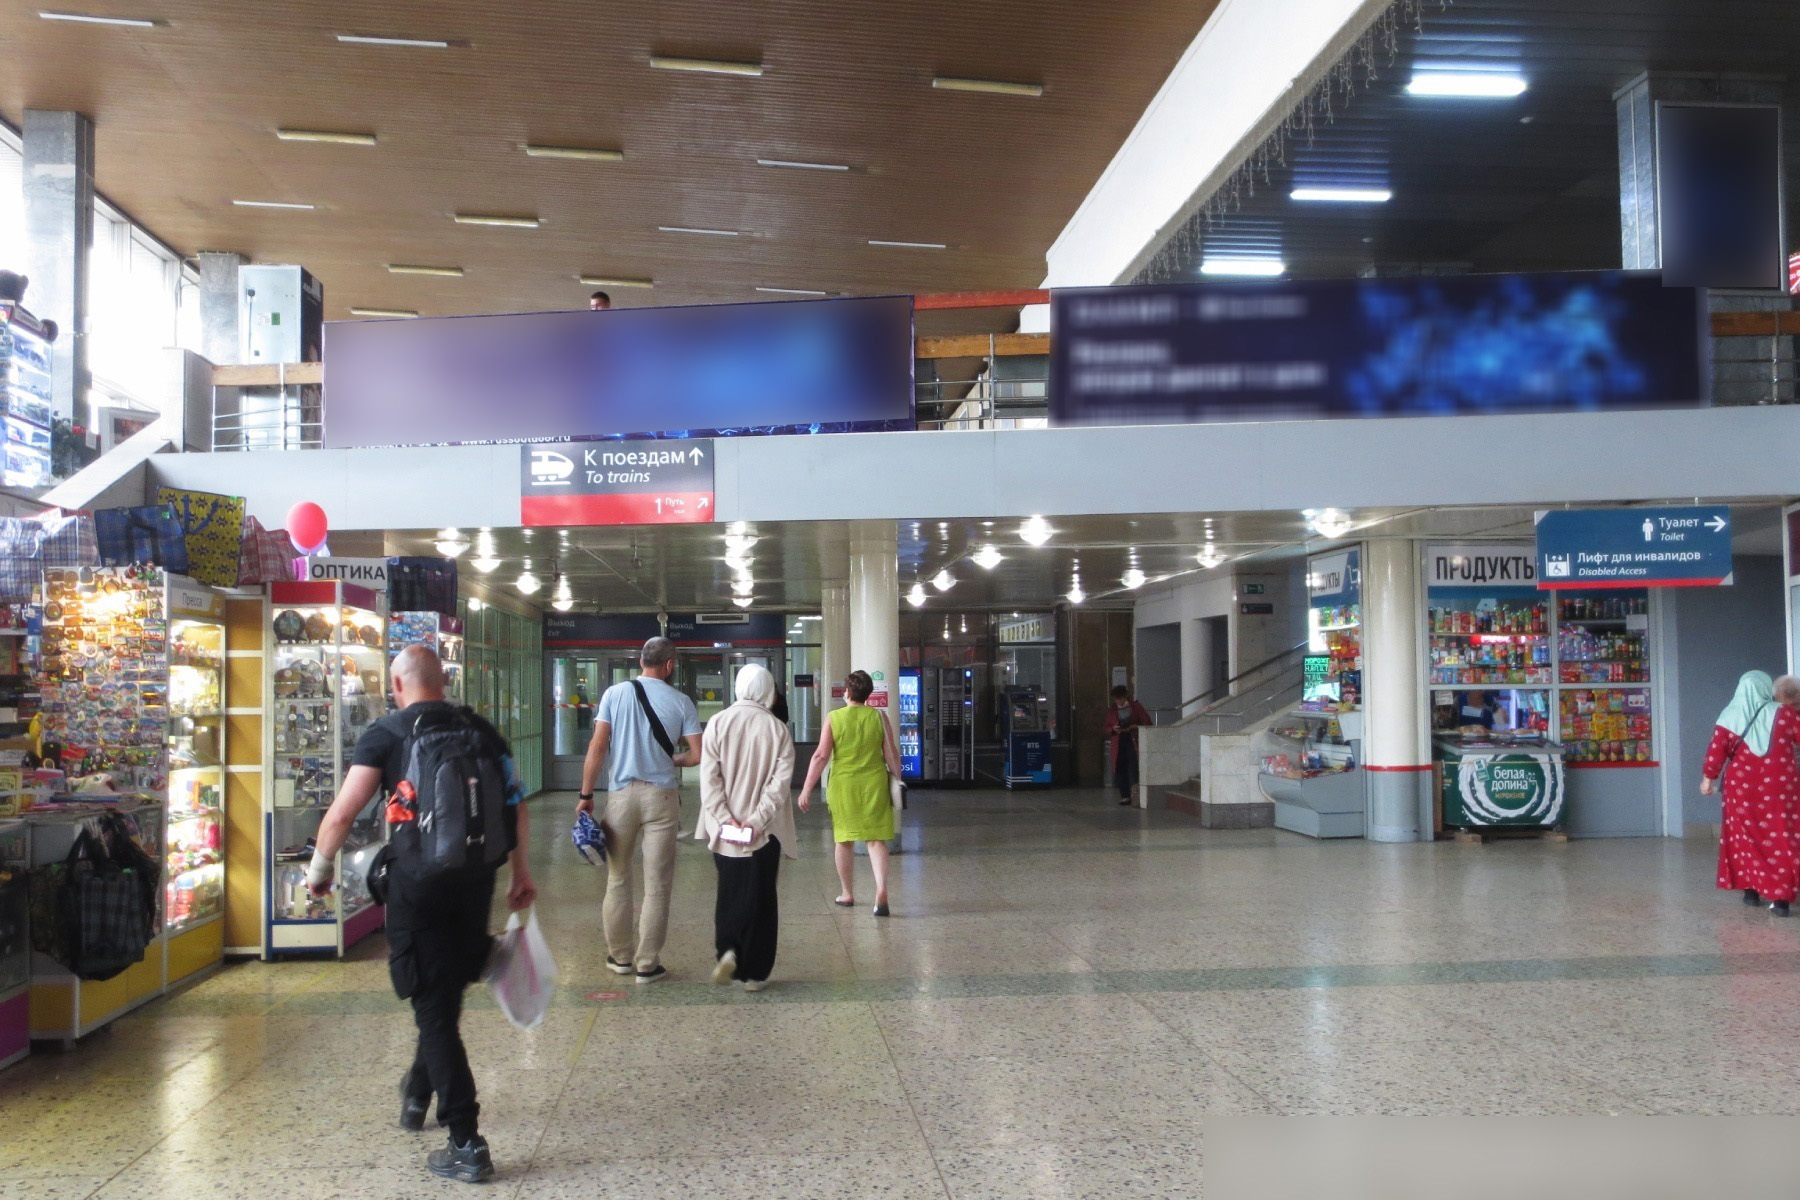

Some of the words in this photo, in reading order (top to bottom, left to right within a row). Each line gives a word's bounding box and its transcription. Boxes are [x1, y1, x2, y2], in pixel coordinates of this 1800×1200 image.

[584, 449, 597, 466] К
[602, 450, 685, 467] поездам
[586, 470, 603, 484] To
[607, 469, 651, 484] trains
[655, 497, 663, 515] 1
[665, 497, 685, 507] Путь
[1658, 517, 1699, 529] Туалет
[1660, 532, 1684, 541] Toilet
[1577, 552, 1608, 564] Лифт
[1611, 553, 1632, 563] для
[1635, 551, 1701, 562] инвалидов
[311, 564, 386, 580] ОПТИКА
[1578, 566, 1615, 576] Disabled
[1618, 566, 1647, 575] Access
[547, 618, 575, 628] Выход
[669, 622, 694, 631] Выход
[1493, 766, 1525, 780] белая
[1491, 780, 1528, 792] долина
